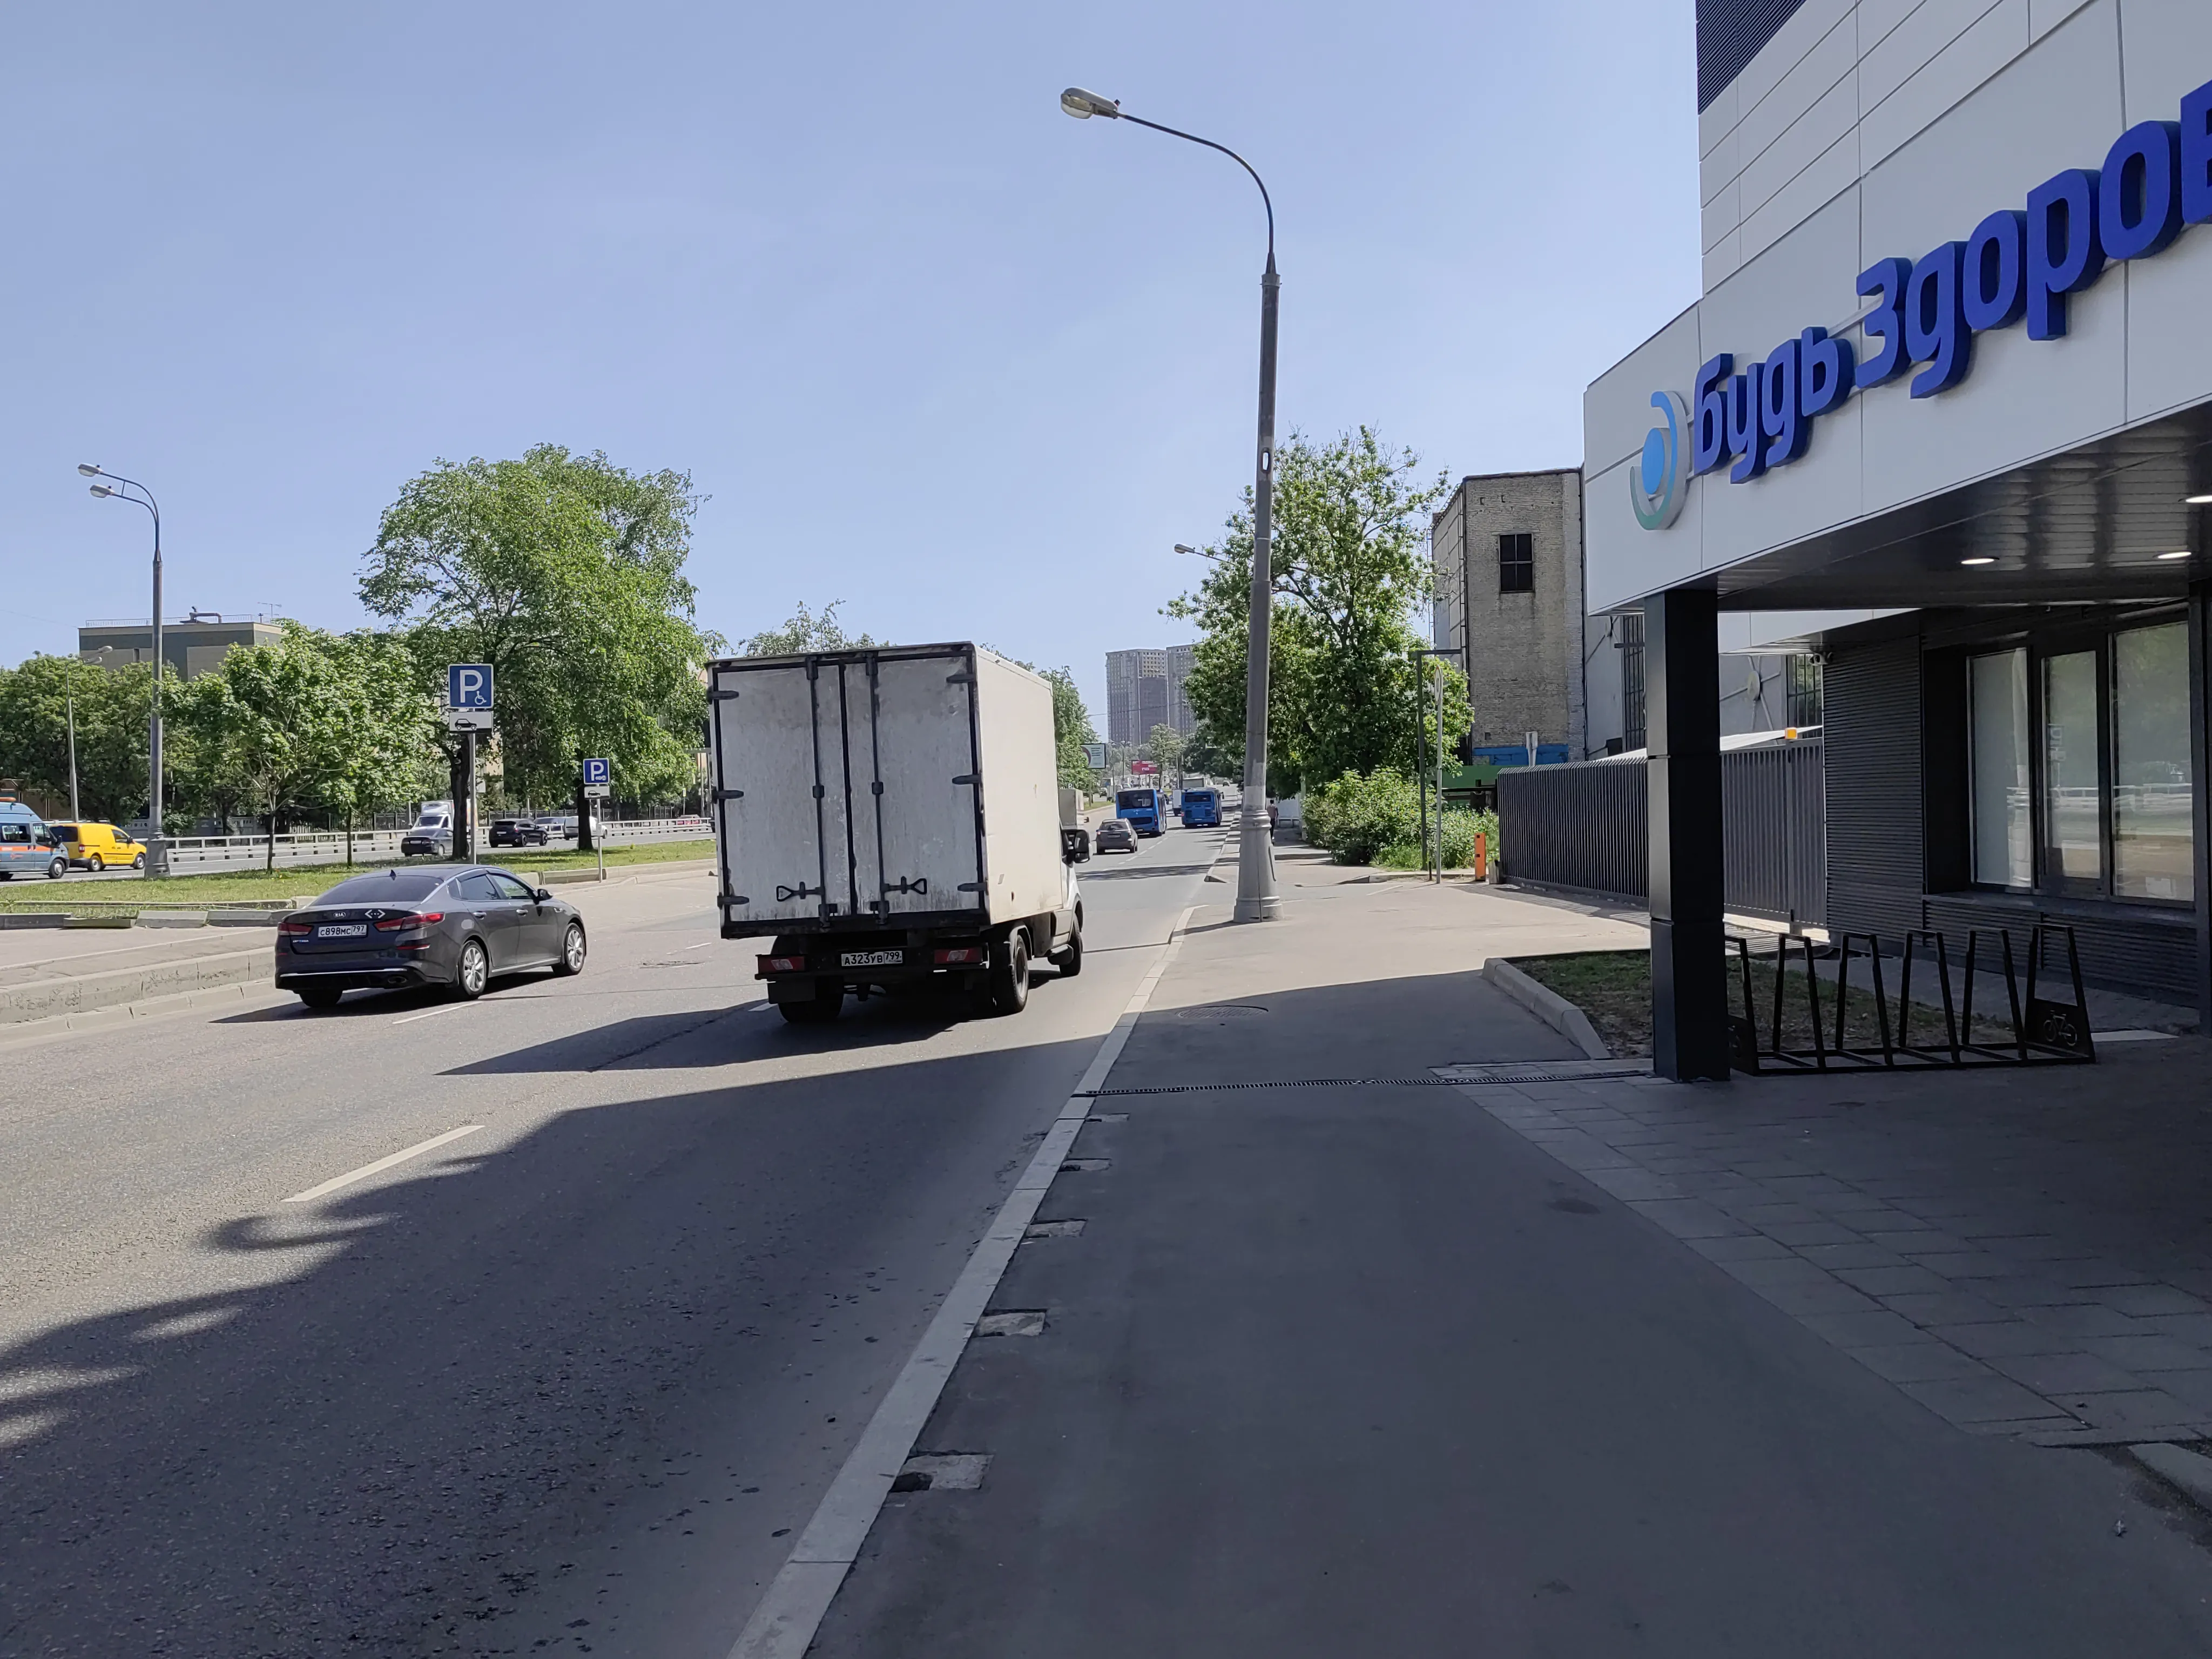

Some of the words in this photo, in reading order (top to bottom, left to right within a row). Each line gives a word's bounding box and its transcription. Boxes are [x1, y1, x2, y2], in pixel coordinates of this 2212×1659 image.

[460, 670, 483, 703] P
[590, 761, 604, 781] P
[885, 952, 900, 960] 799
